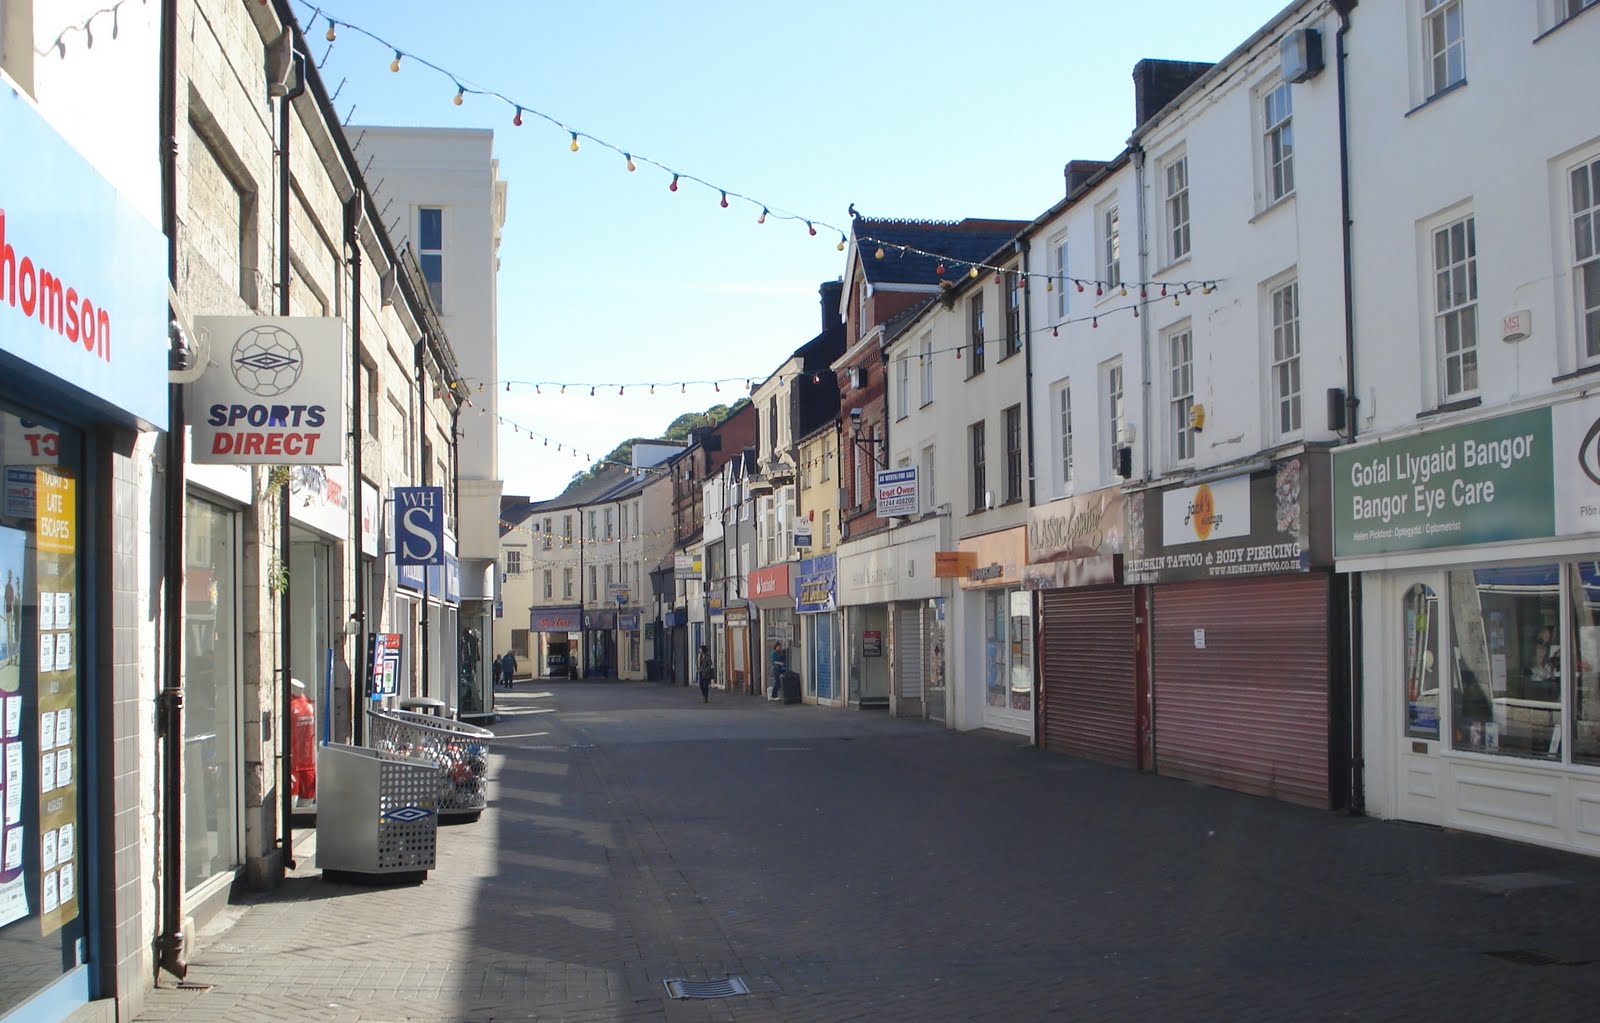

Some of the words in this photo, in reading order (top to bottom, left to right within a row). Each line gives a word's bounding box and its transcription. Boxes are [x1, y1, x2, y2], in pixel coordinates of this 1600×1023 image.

[207, 404, 326, 427] SPORTS
[211, 432, 321, 455] DIRECT
[1351, 457, 1390, 488] Gofal
[1396, 443, 1456, 484] Llygaid
[1463, 434, 1534, 469] Bangor
[46, 494, 63, 513] LATE
[401, 492, 435, 507] WH
[879, 488, 895, 500] Legat
[896, 486, 915, 495] Owen
[1353, 493, 1408, 523] Bangor
[1414, 485, 1445, 517] Eye
[1452, 478, 1495, 507] Care
[1184, 496, 1211, 526] jack's
[41, 518, 70, 540] ESCAPES
[403, 507, 438, 560] S
[1030, 516, 1067, 551] CLASSIC
[1353, 530, 1369, 541] Helen
[1425, 520, 1461, 535] Optometrist
[1128, 556, 1166, 572] REDSKIN
[1166, 552, 1202, 568] TATTOO
[1205, 552, 1213, 565] &
[1216, 548, 1245, 564] BODY
[1246, 543, 1301, 561] PIERCING
[1208, 559, 1302, 576] WWW.REDSKINTATTOO.CO.UK
[47, 797, 63, 813] AUGUST
